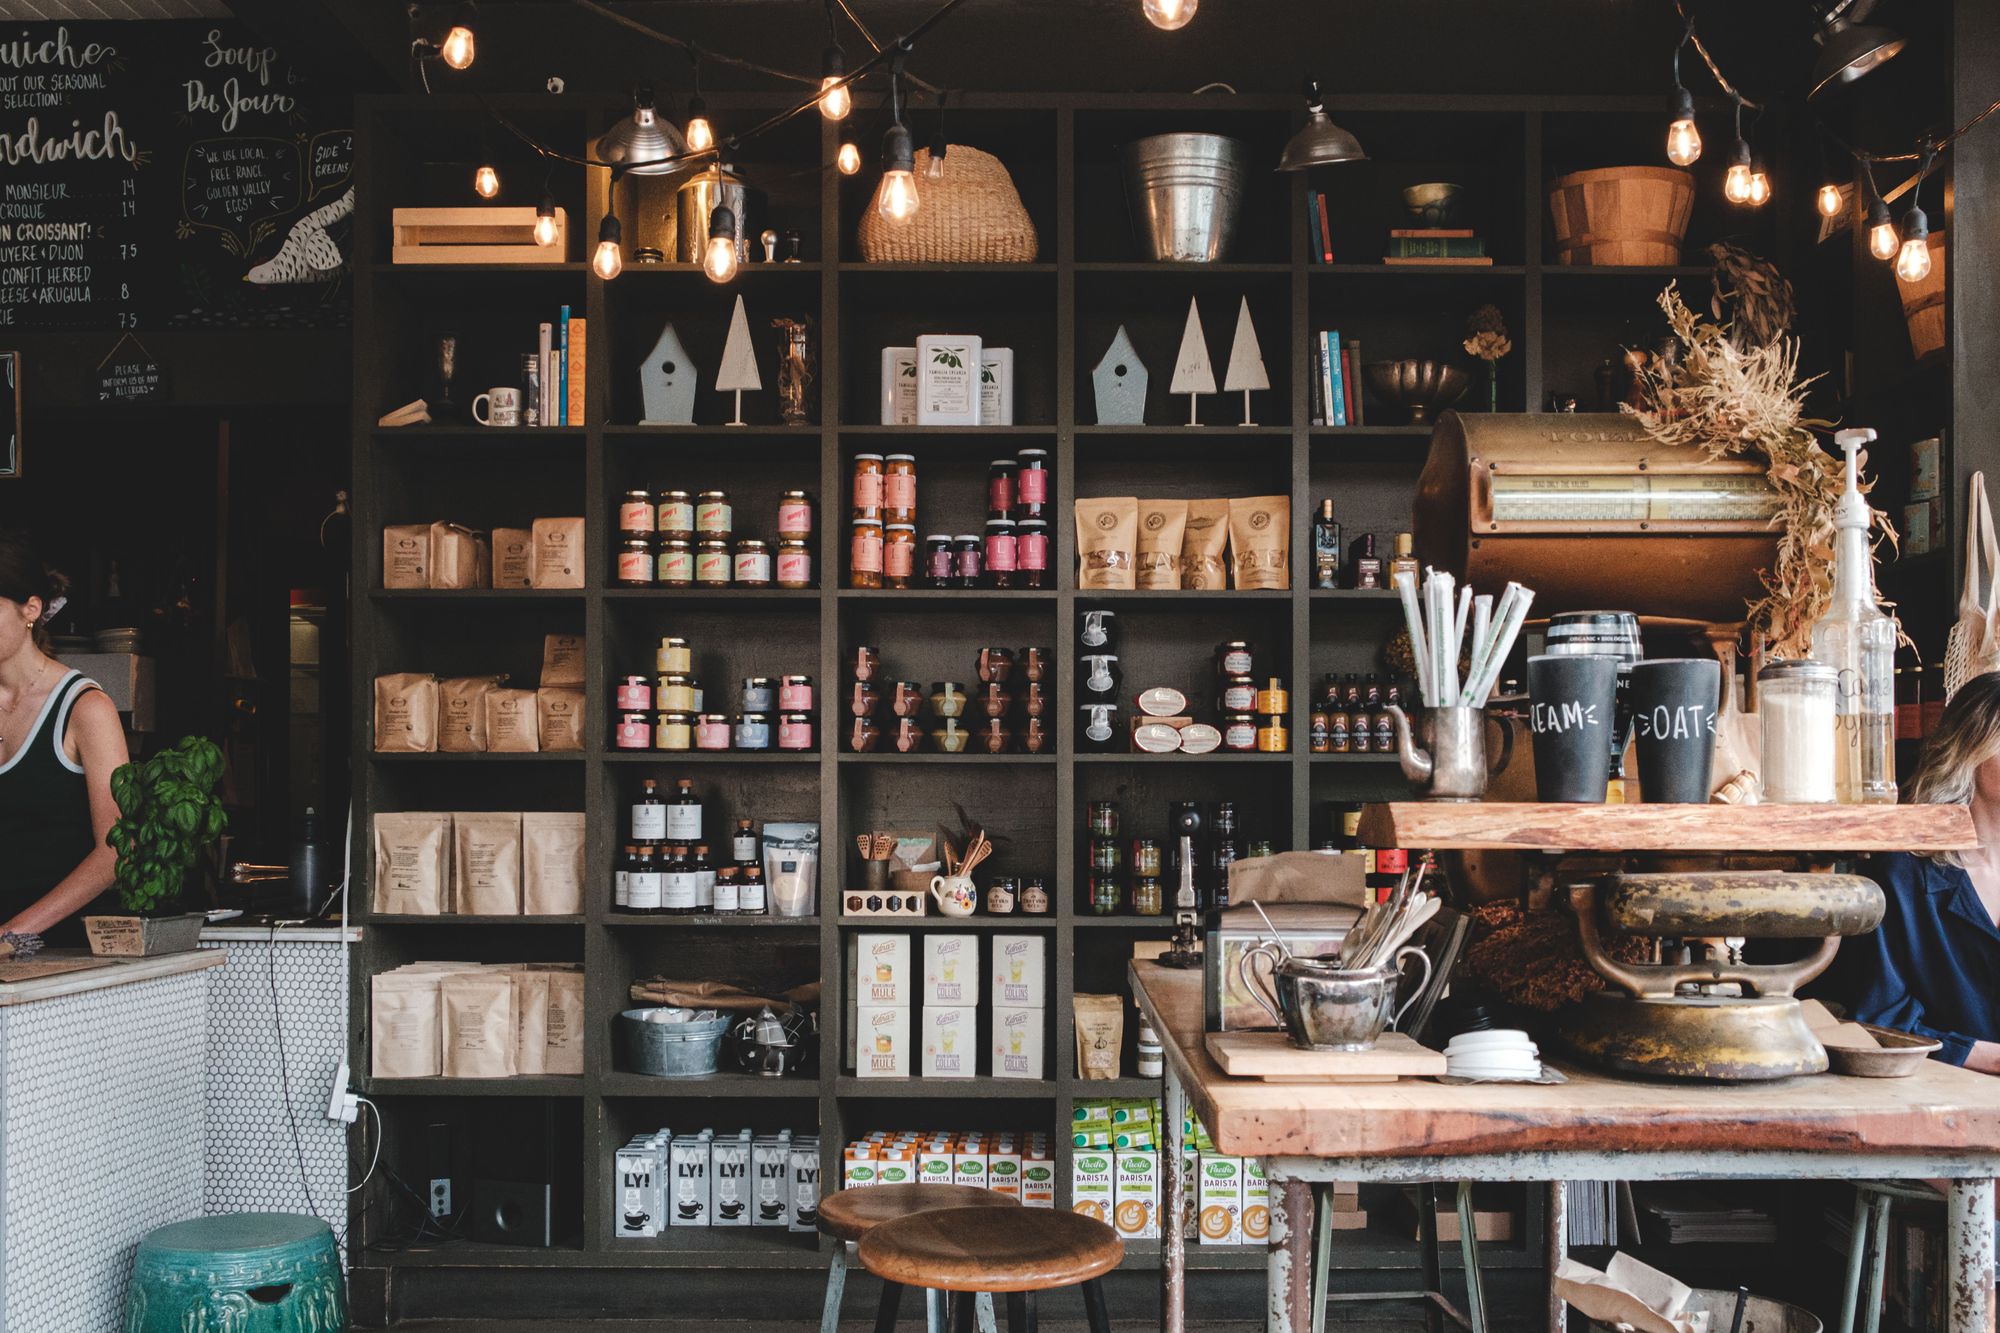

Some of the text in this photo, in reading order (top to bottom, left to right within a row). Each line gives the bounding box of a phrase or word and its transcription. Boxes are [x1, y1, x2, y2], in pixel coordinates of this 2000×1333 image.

[0, 26, 116, 69] uiche
[202, 29, 277, 86] Soup
[23, 75, 46, 91] OUR
[51, 73, 106, 91] SEASONAL
[4, 92, 62, 109] SELECTION!
[182, 78, 295, 132] Du Jour
[0, 110, 136, 165] ndwich
[206, 153, 220, 164] WE
[222, 150, 237, 161] USE
[316, 145, 339, 163] SIDE
[5, 179, 135, 201] MONSIEUR 14
[206, 180, 271, 200] GOLDEN VALLEY
[0, 200, 135, 220] CROQUE 14
[16, 222, 91, 241] CROISSANT!
[0, 245, 38, 262] UYERE
[49, 244, 84, 261] DIJON
[47, 266, 91, 284] HERBED
[0, 287, 30, 304] EESE
[38, 286, 91, 305] ARUGULA
[120, 283, 130, 300] 8
[0, 308, 15, 326] IE
[115, 364, 139, 376] PLEASE
[102, 378, 127, 388] INFORM
[146, 375, 159, 384] ANY
[1617, 679, 1630, 689] NE
[1653, 704, 1704, 740] OAT
[872, 988, 896, 998] MULE
[937, 987, 961, 998] COLLINS
[1005, 988, 1028, 999] COLLINS
[872, 1058, 896, 1068] MULE
[936, 1058, 960, 1068] COLLINS
[1005, 1059, 1028, 1069] COLLINS
[679, 1163, 703, 1178] LY!
[720, 1163, 744, 1178] LY!
[760, 1163, 784, 1178] LY!
[1080, 1158, 1104, 1168] Pacific
[1124, 1158, 1148, 1168] Pacific
[1208, 1163, 1233, 1173] Pacific
[625, 1173, 649, 1188] LY!
[1076, 1174, 1109, 1182] BARISTA
[1120, 1174, 1153, 1182] BARISTA
[1246, 1179, 1270, 1187] BARIS
